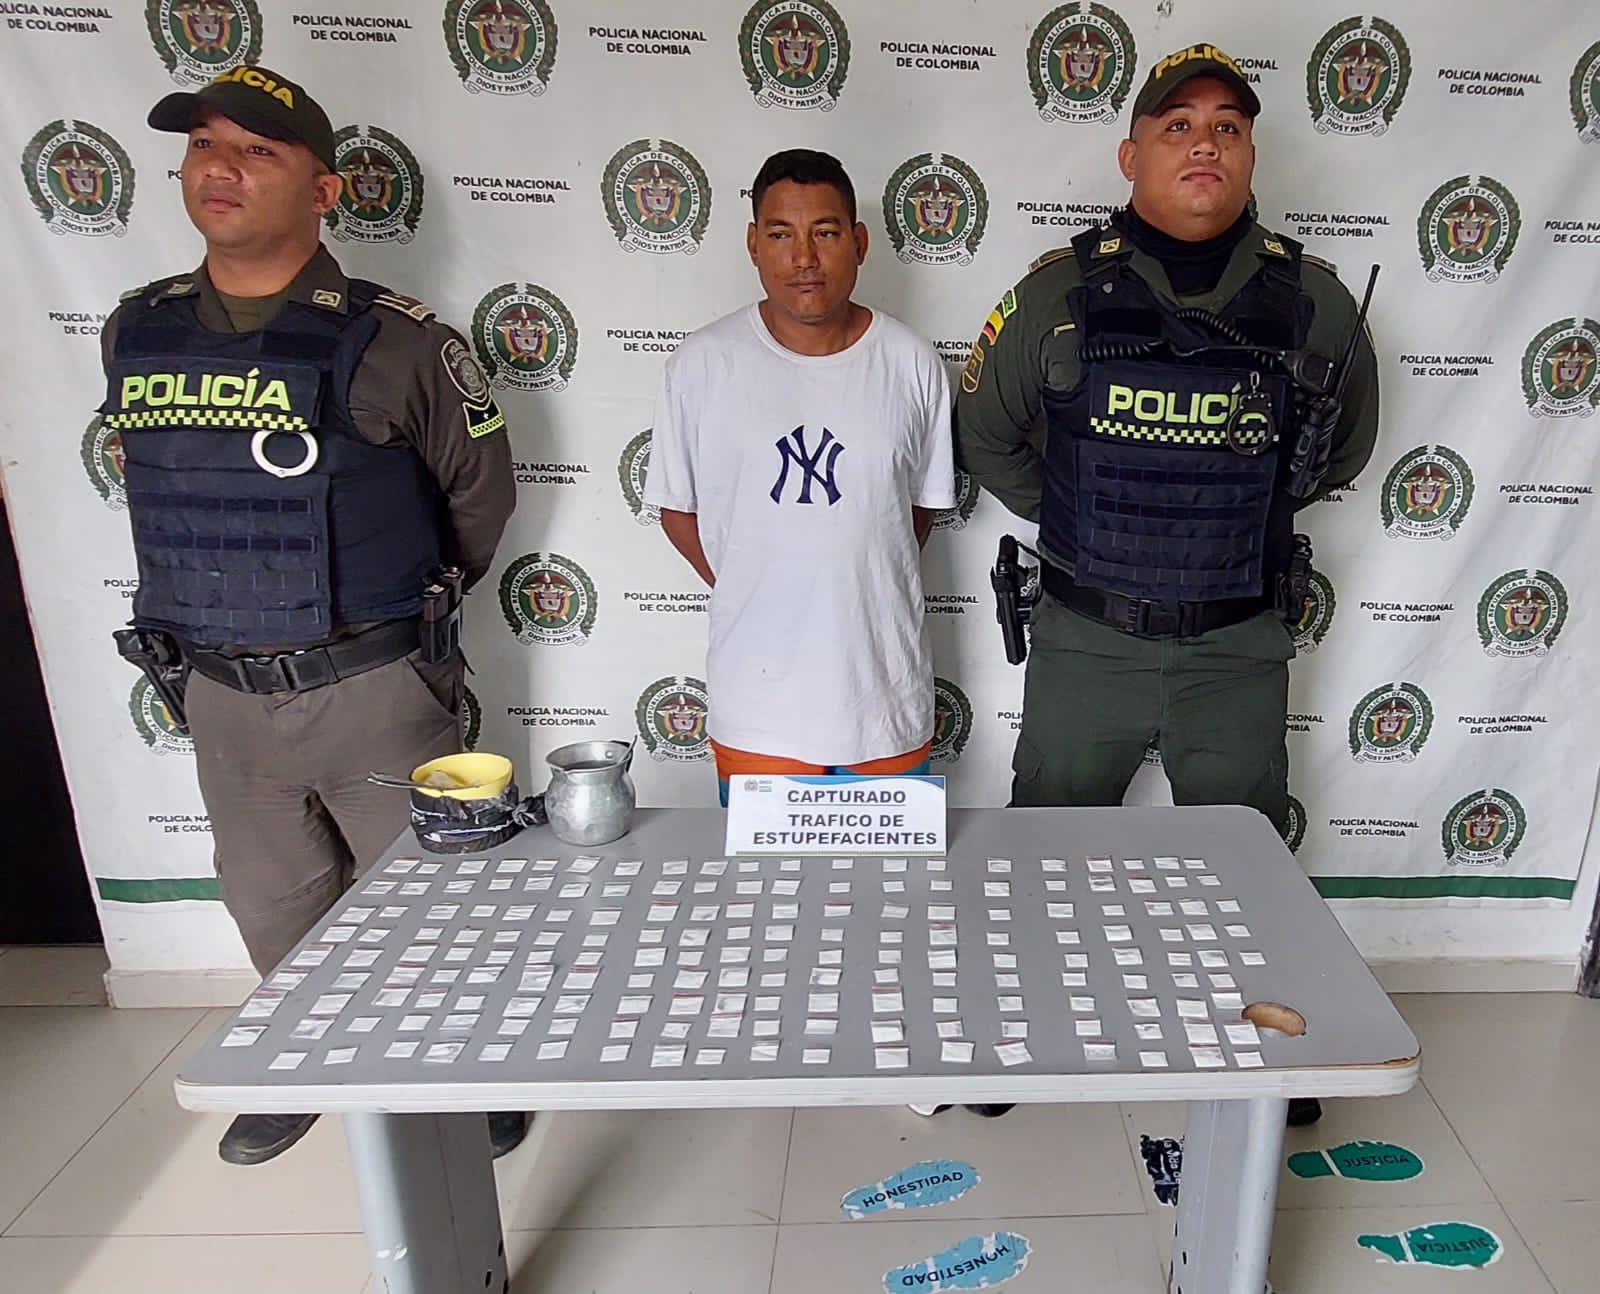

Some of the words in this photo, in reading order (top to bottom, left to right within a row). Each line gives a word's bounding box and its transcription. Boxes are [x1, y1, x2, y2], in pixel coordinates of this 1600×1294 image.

[0, 4, 40, 15] OLICIA
[43, 7, 112, 18] NACIONAL
[8, 19, 23, 29] DE
[26, 20, 99, 32] COLOMBIA
[293, 16, 342, 27] POLICIA
[346, 17, 412, 29] NACIONAL
[311, 30, 327, 40] DE
[331, 31, 396, 42] COLOMBIA
[589, 27, 639, 38] POLICIA
[642, 30, 706, 41] NACIONAL
[753, 7, 781, 54] REPUBLICA
[811, 10, 837, 59] COLOMBIA
[607, 43, 623, 53] DE
[627, 44, 691, 54] COLOMBIA
[881, 42, 928, 53] POLICIA
[933, 45, 996, 56] NACIONAL
[1041, 19, 1071, 68] REPUBLICA
[1100, 22, 1122, 71] COLOMBIA
[897, 58, 912, 67] DE
[916, 59, 979, 70] COLOMBIA
[1233, 59, 1278, 70] CIONAL
[1320, 35, 1352, 82] REPUBLICA
[1379, 36, 1398, 85] COLOMBIA
[758, 66, 786, 94] POLICIA
[796, 70, 834, 96] NACIONAL
[1439, 69, 1480, 80] POLICIA
[1484, 72, 1541, 83] NACIONAL
[1044, 80, 1070, 107] POLICIA
[1080, 82, 1118, 109] NACIONAL
[1450, 85, 1464, 94] DE
[1467, 86, 1524, 96] COLOMBIA
[1321, 93, 1344, 120] POLICIA
[1353, 95, 1392, 122] NACIONAL
[454, 177, 503, 188] POLICIA
[506, 179, 570, 190] NACIONAL
[616, 157, 642, 201] REPUBLICA
[672, 159, 698, 205] COLOMBIA
[471, 191, 487, 201] DE
[491, 192, 555, 203] COLOMBIA
[896, 170, 924, 214] REPUBLICA
[952, 172, 975, 217] COLOMBIA
[1018, 203, 1063, 213] POLICIA
[1032, 216, 1046, 225] DE
[1050, 217, 1110, 227] COLOMBIA
[1285, 213, 1328, 223] POLICIA
[1331, 215, 1389, 225] NACIONAL
[622, 213, 650, 239] POLICIA
[660, 215, 696, 240] NACIONAL
[1298, 226, 1312, 236] DE
[1315, 227, 1373, 237] COLOMBIA
[1545, 221, 1583, 231] POLICIA
[901, 224, 926, 250] POLICIA
[936, 228, 971, 252] NACIONAL
[1553, 234, 1567, 243] DE
[49, 312, 92, 322] POLICIA
[486, 299, 509, 342] REPUBLICA
[538, 301, 565, 345] COLOMBIA
[64, 326, 77, 334] DE
[607, 330, 654, 340] POLICIA
[624, 343, 638, 352] DE
[492, 352, 520, 376] POLICIA
[529, 355, 563, 378] NACIONAL
[1400, 355, 1441, 365] POLICIA
[1444, 357, 1493, 366] NACIONAL
[1412, 367, 1426, 376] DE
[1429, 368, 1478, 377] COLOMBIA
[121, 367, 291, 412] POLICÍA
[531, 463, 589, 473] NACIONAL
[770, 425, 845, 506] NY
[517, 475, 575, 485] COLOMBIA
[1500, 484, 1536, 493] POLICIA
[1539, 485, 1592, 495] NACIONAL
[1509, 496, 1523, 504] DE
[1526, 496, 1579, 505] COLOMBIA
[624, 592, 667, 601] POLICIA
[670, 594, 710, 602] NACION
[924, 595, 977, 604] NACIONAL
[639, 604, 653, 612] DE
[656, 604, 706, 612] COLOMBI
[925, 606, 964, 614] LOMBIA
[1361, 602, 1401, 610] POLICIA
[1405, 603, 1454, 611] NACIONAL
[1373, 614, 1386, 622] DE
[507, 707, 550, 715] POLICIA
[553, 708, 608, 716] NACIONAL
[1286, 715, 1324, 723] CIONAL
[1458, 716, 1497, 725] POLICIA
[1499, 715, 1547, 723] NACIONAL
[1485, 725, 1532, 733] COLOMBIA
[787, 790, 906, 804] CAPTURADO
[149, 815, 192, 823] POLICIA
[789, 814, 872, 827] TRAFICO
[879, 814, 904, 827] DE
[1329, 819, 1366, 827] POLICIA
[1369, 820, 1419, 828] NACIONAL
[753, 831, 937, 845] ESTUPEFACIENTES
[1355, 829, 1406, 837] COLOMBIA
[1343, 1155, 1409, 1168] JUSTICIA
[863, 1172, 963, 1207] HONESTIDAD
[1416, 1237, 1490, 1254] JUSTICIA
[902, 1245, 1009, 1286] HONESTIDAD
